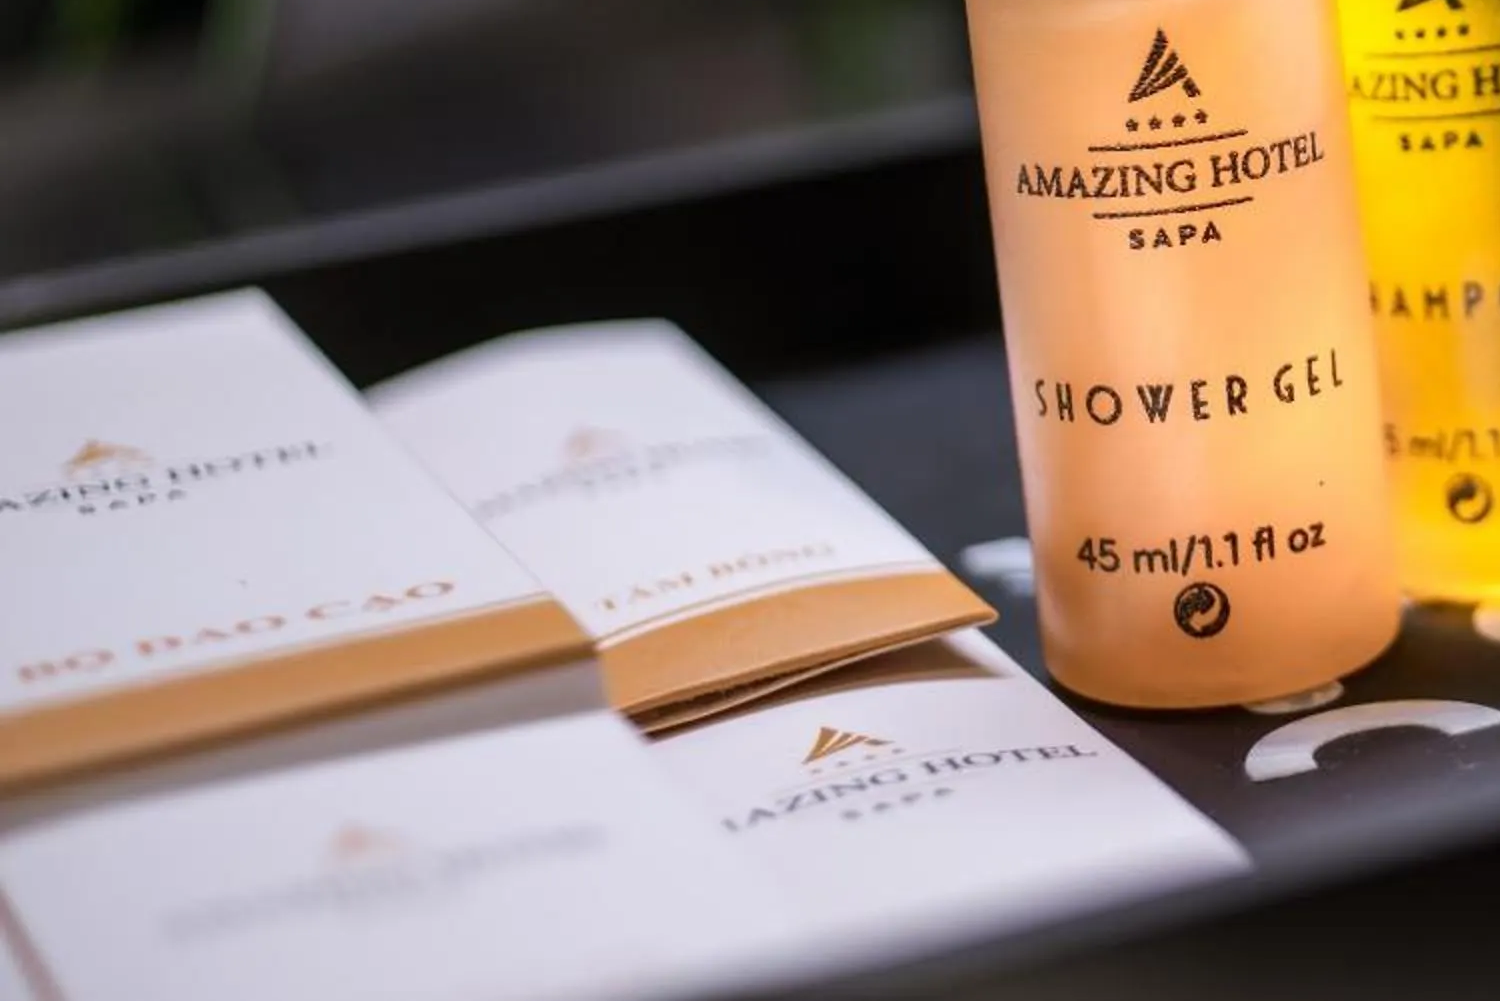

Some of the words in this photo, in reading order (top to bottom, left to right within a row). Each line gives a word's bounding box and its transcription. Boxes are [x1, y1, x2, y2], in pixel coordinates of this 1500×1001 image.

[1398, 130, 1483, 152] SAPA
[1017, 159, 1197, 199] AMAZING
[1210, 131, 1325, 188] HOTEL
[1128, 220, 1222, 250] SAPA
[1034, 375, 1249, 426] SHOWER
[1273, 348, 1344, 404] GEL
[1077, 537, 1121, 573] 45
[1133, 531, 1241, 577] ml/1.1
[1253, 524, 1275, 562] fl
[1288, 520, 1327, 554] oz
[920, 742, 1099, 777] HOTEL
